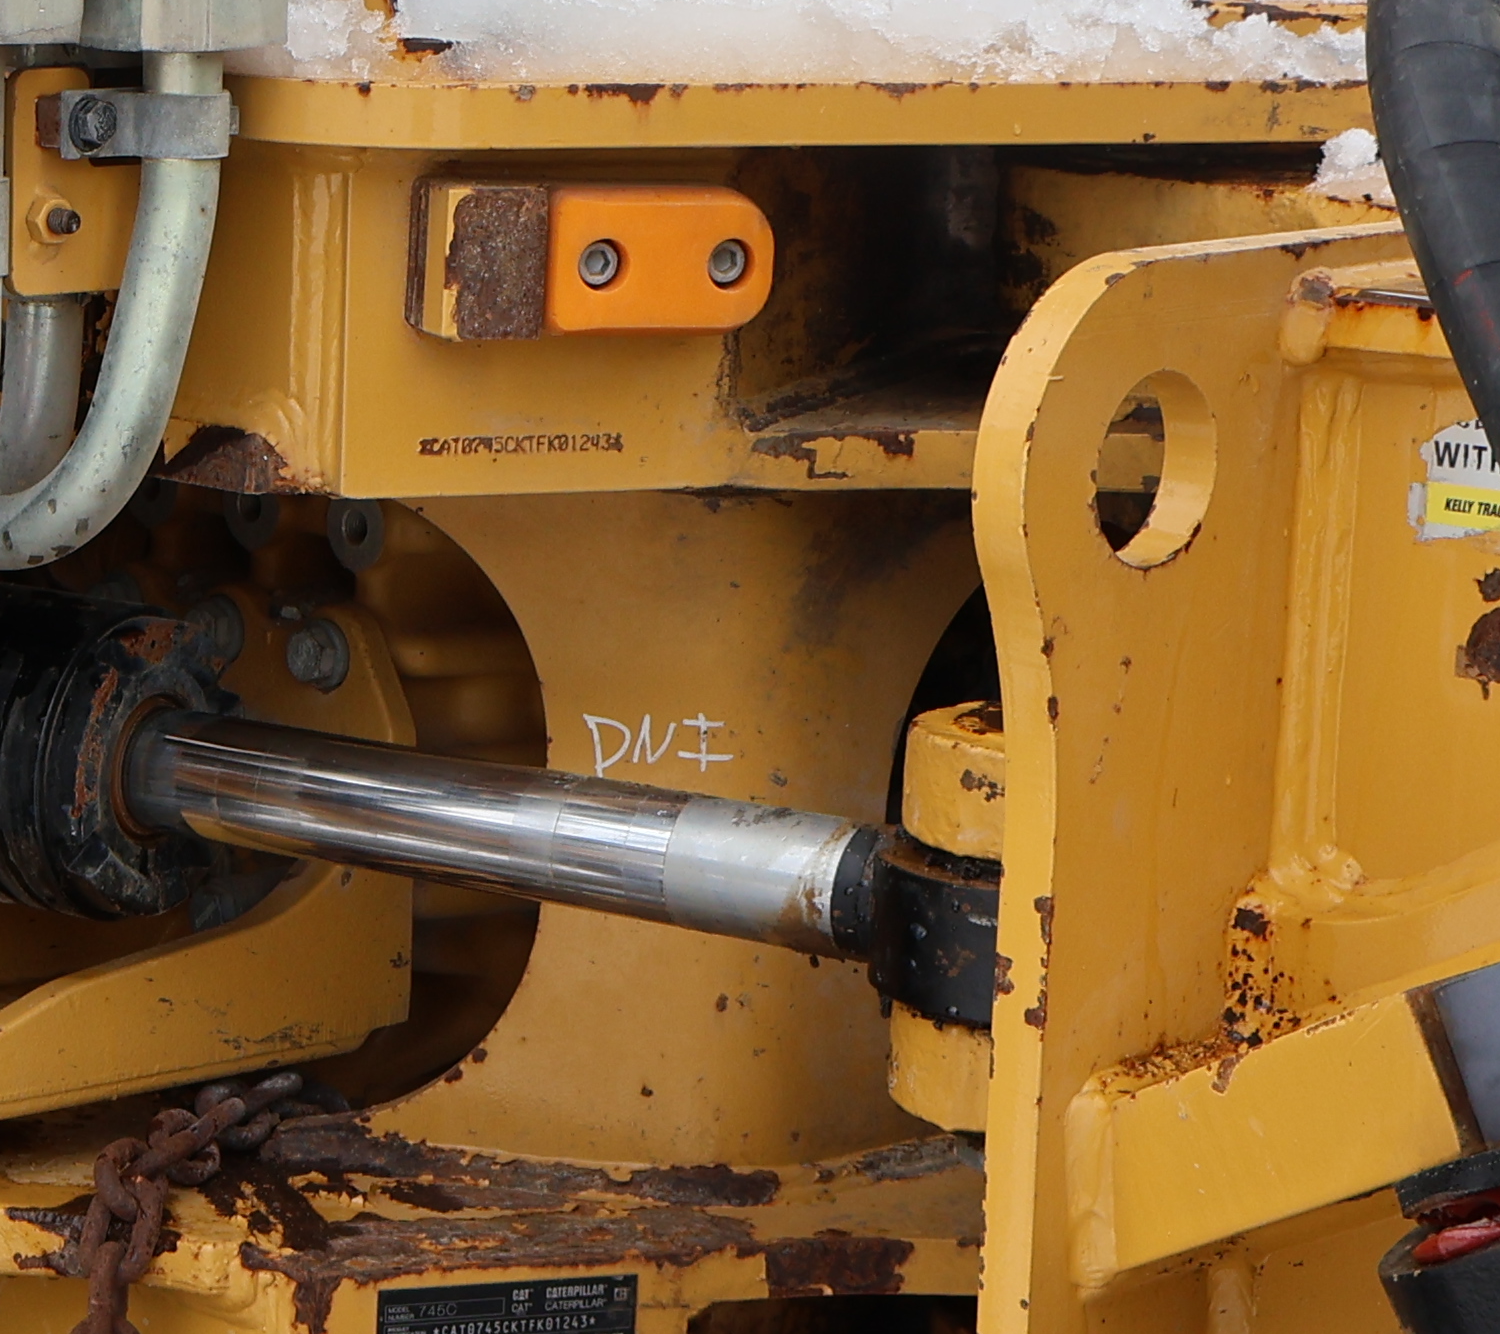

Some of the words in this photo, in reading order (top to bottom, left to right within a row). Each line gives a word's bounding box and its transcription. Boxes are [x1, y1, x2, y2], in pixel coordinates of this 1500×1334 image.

[1444, 497, 1476, 514] KELLY
[512, 1288, 531, 1302] CAT
[546, 1284, 605, 1299] CATERPILLAR
[419, 1303, 458, 1318] 745C
[511, 1302, 530, 1314] CAT
[545, 1298, 605, 1311] CATERPILLAR
